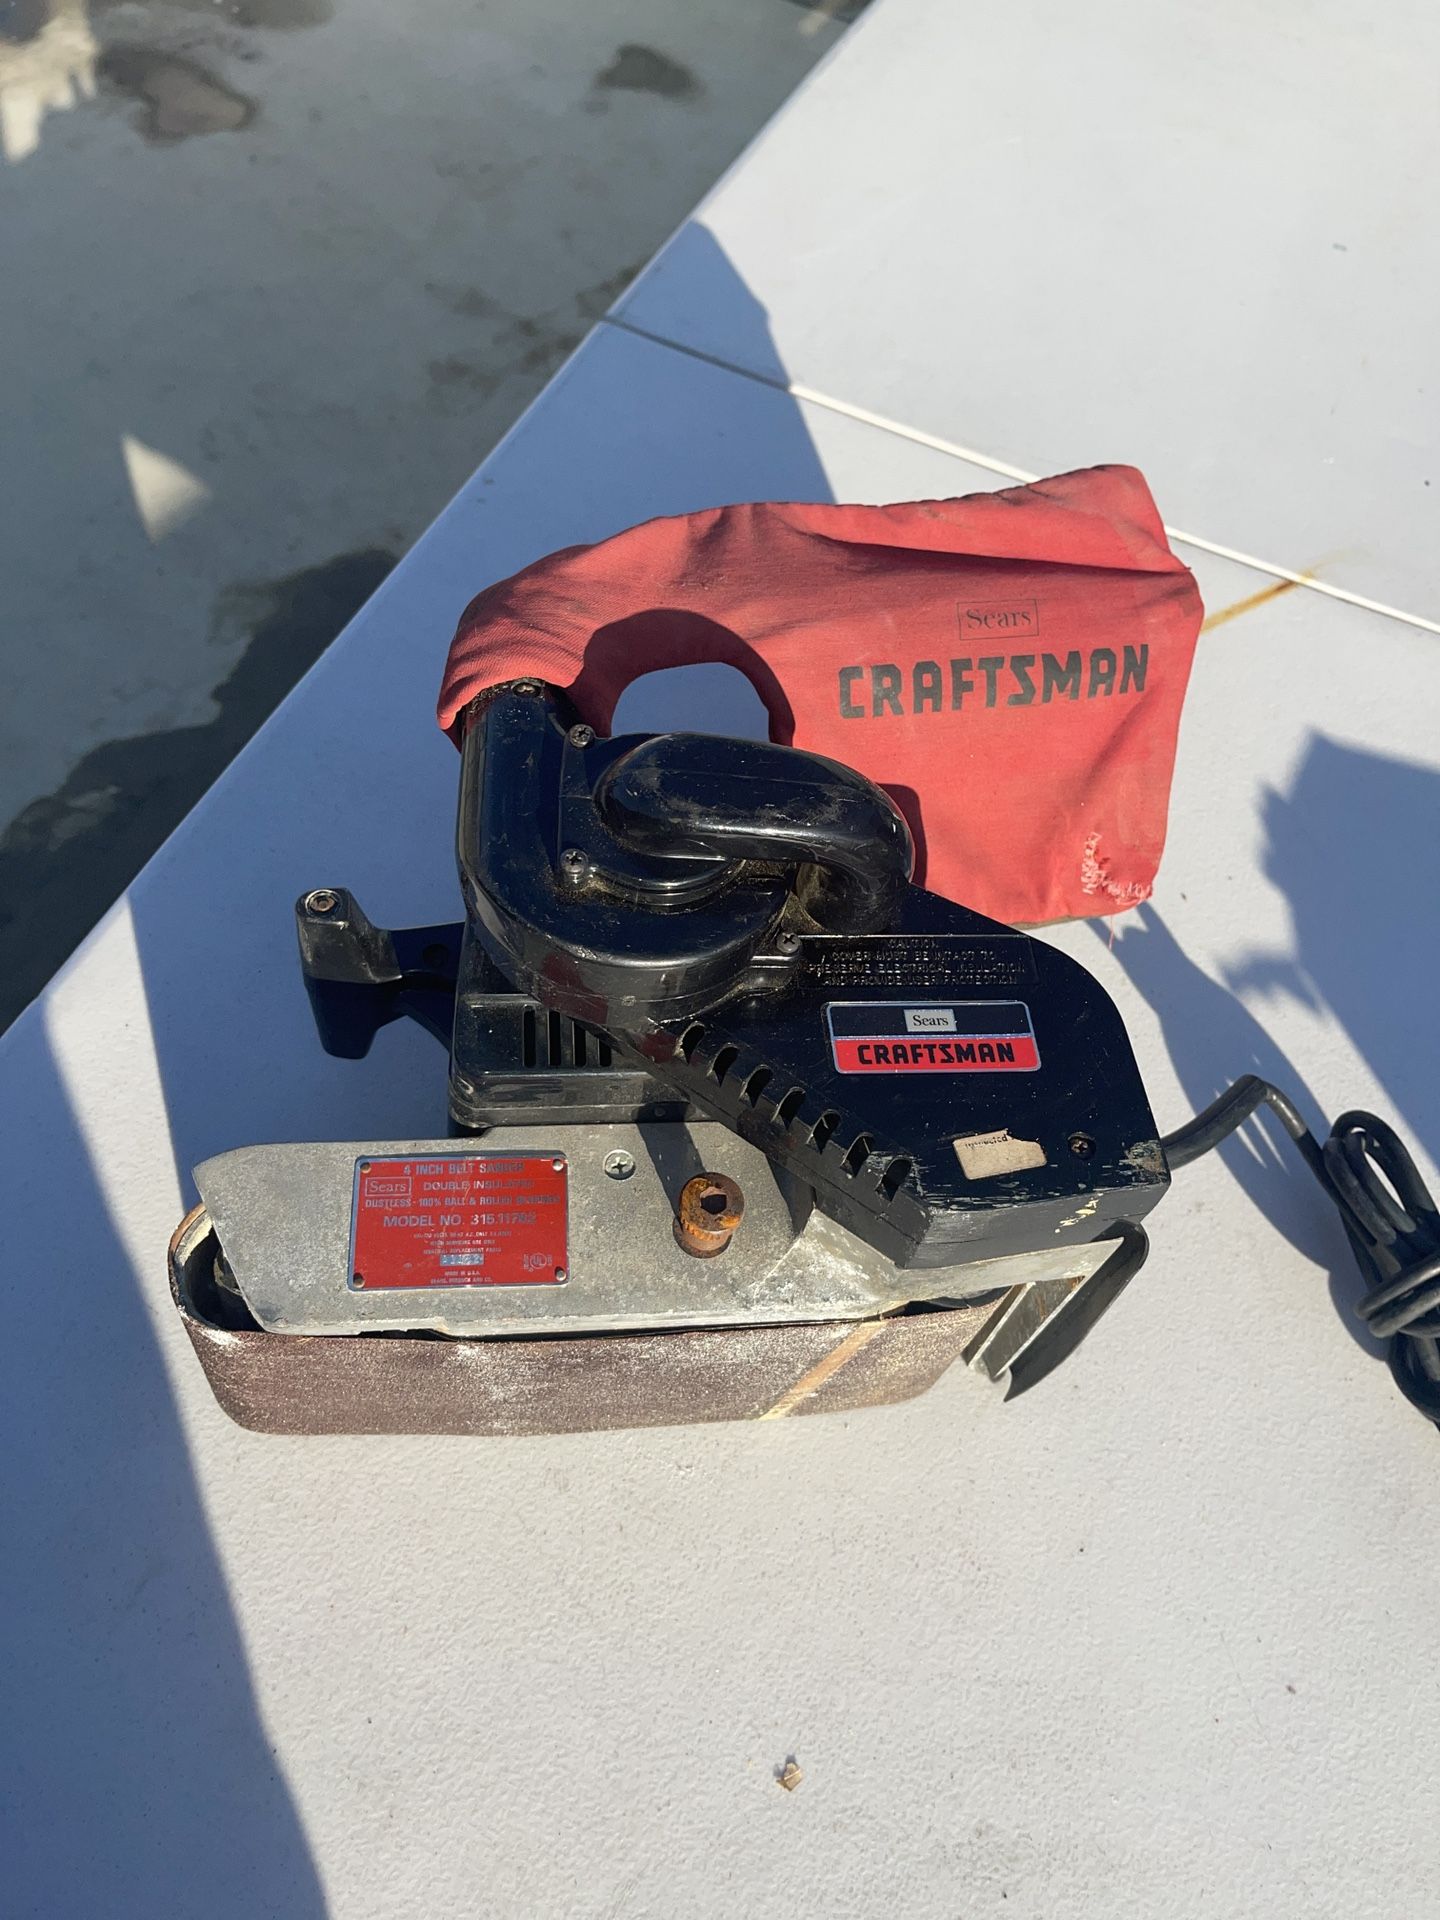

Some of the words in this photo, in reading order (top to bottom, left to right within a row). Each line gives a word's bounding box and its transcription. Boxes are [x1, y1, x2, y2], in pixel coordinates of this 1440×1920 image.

[965, 607, 1033, 630] Sears
[838, 643, 1149, 720] CRAFTSMAN
[887, 938, 939, 949] CAUTION
[832, 950, 872, 962] COVER
[876, 950, 907, 961] MUST
[914, 950, 929, 961] BE
[932, 950, 976, 961] INTACT
[980, 950, 995, 961] TO
[806, 962, 871, 975] PRESERVE
[878, 962, 953, 974] ELECTRICAL
[957, 961, 1025, 973] INSULATION
[822, 975, 846, 986] AND
[852, 974, 903, 986] PROVIDE
[944, 973, 1018, 985] PROTECTION
[912, 1014, 949, 1028] Sears
[857, 1042, 1016, 1065] CRAFTSMAN
[403, 1164, 411, 1176] 4
[415, 1163, 444, 1175] INCH
[448, 1162, 475, 1175] BELT
[369, 1180, 407, 1193] Sears
[423, 1180, 470, 1191] DOUBLE
[365, 1198, 411, 1208] DUSTLESS
[383, 1214, 434, 1228] MODEL
[439, 1213, 466, 1226] NO.
